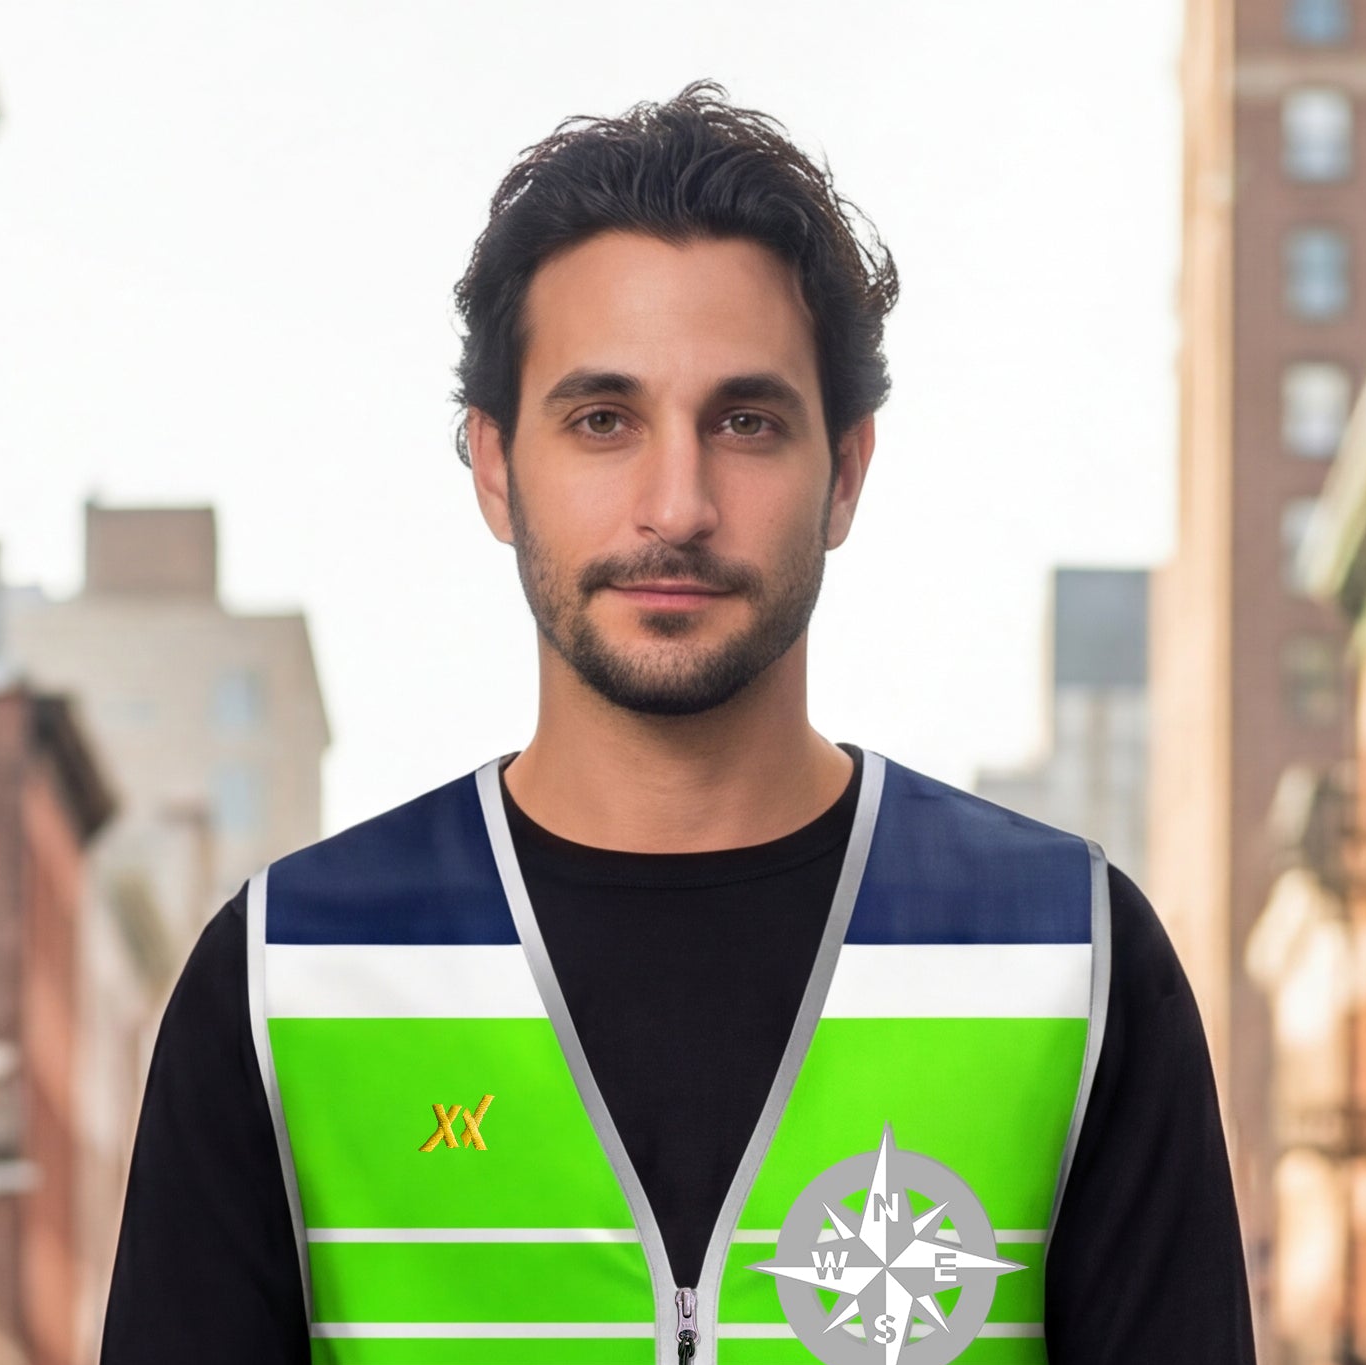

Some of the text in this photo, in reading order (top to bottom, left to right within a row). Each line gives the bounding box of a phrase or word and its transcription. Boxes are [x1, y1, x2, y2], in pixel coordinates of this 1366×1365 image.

[873, 1192, 899, 1222] N
[811, 1250, 849, 1280] W
[934, 1252, 957, 1282] E
[873, 1314, 897, 1345] S
